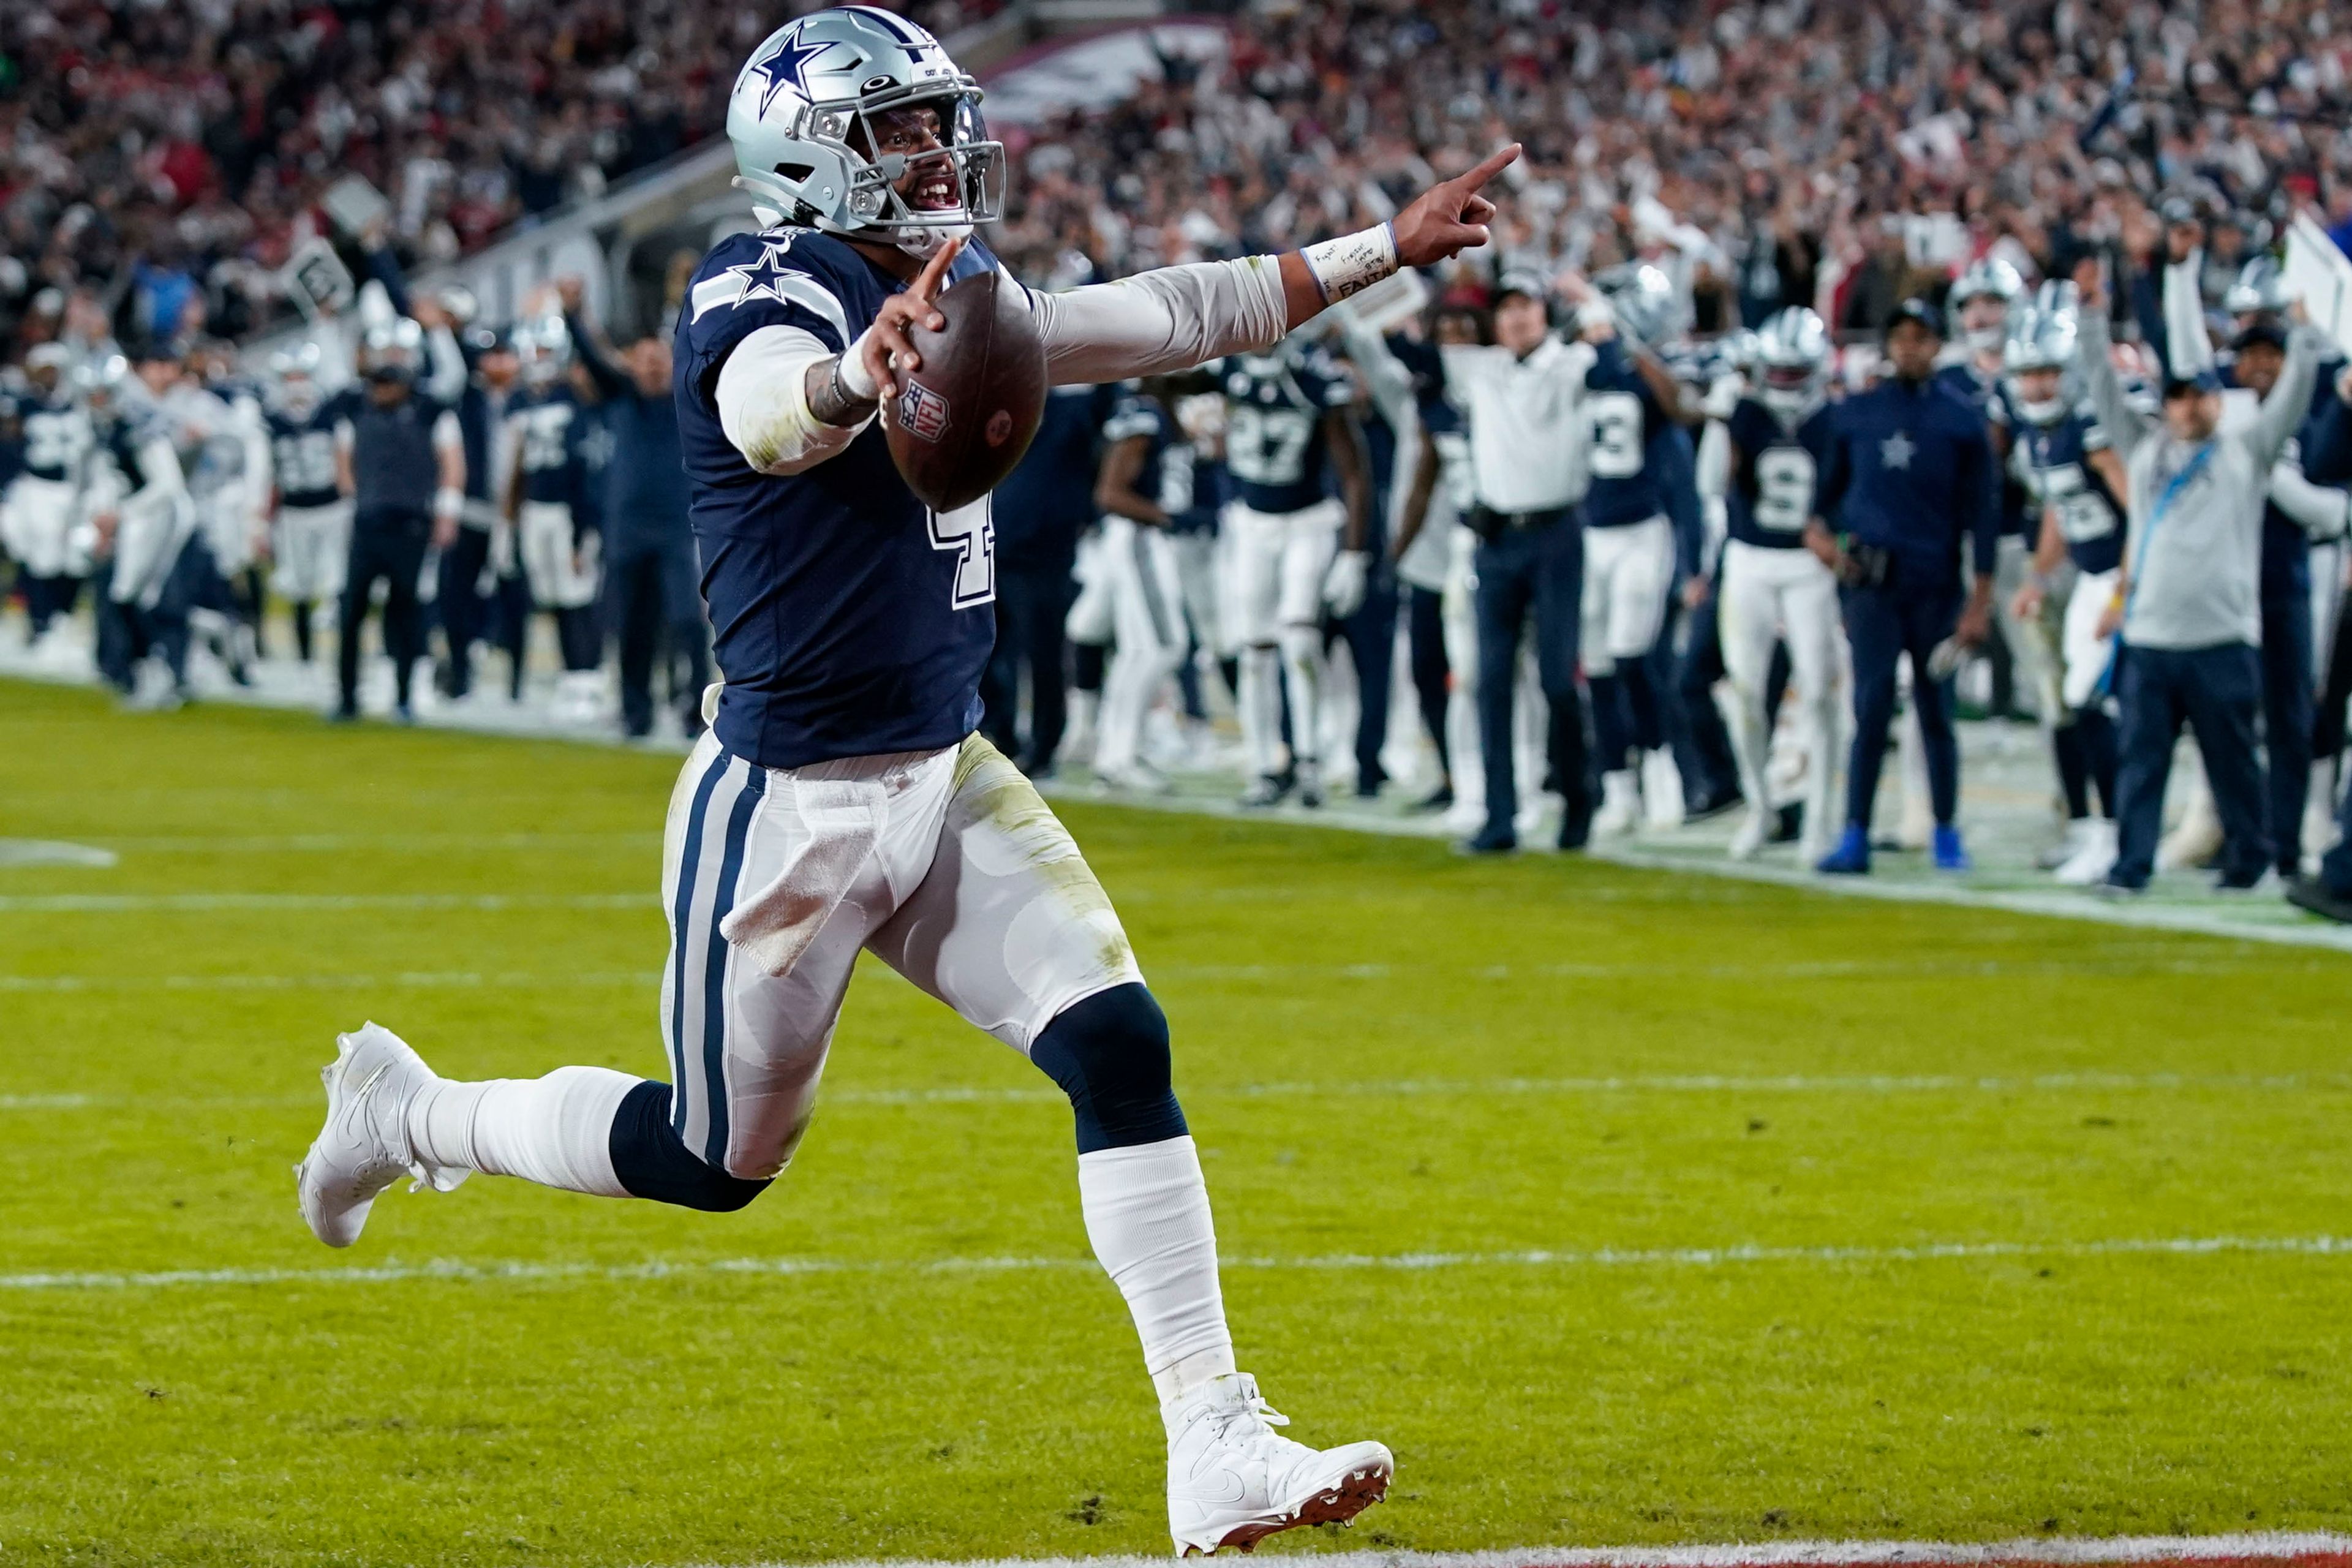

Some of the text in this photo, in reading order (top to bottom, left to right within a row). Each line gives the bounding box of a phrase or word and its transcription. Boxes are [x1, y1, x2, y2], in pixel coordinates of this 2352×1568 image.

[1338, 266, 1392, 297] FAITH
[916, 399, 944, 437] NFL
[1227, 405, 1312, 485] 27
[1754, 448, 1816, 533] 9
[925, 489, 997, 611] 4
